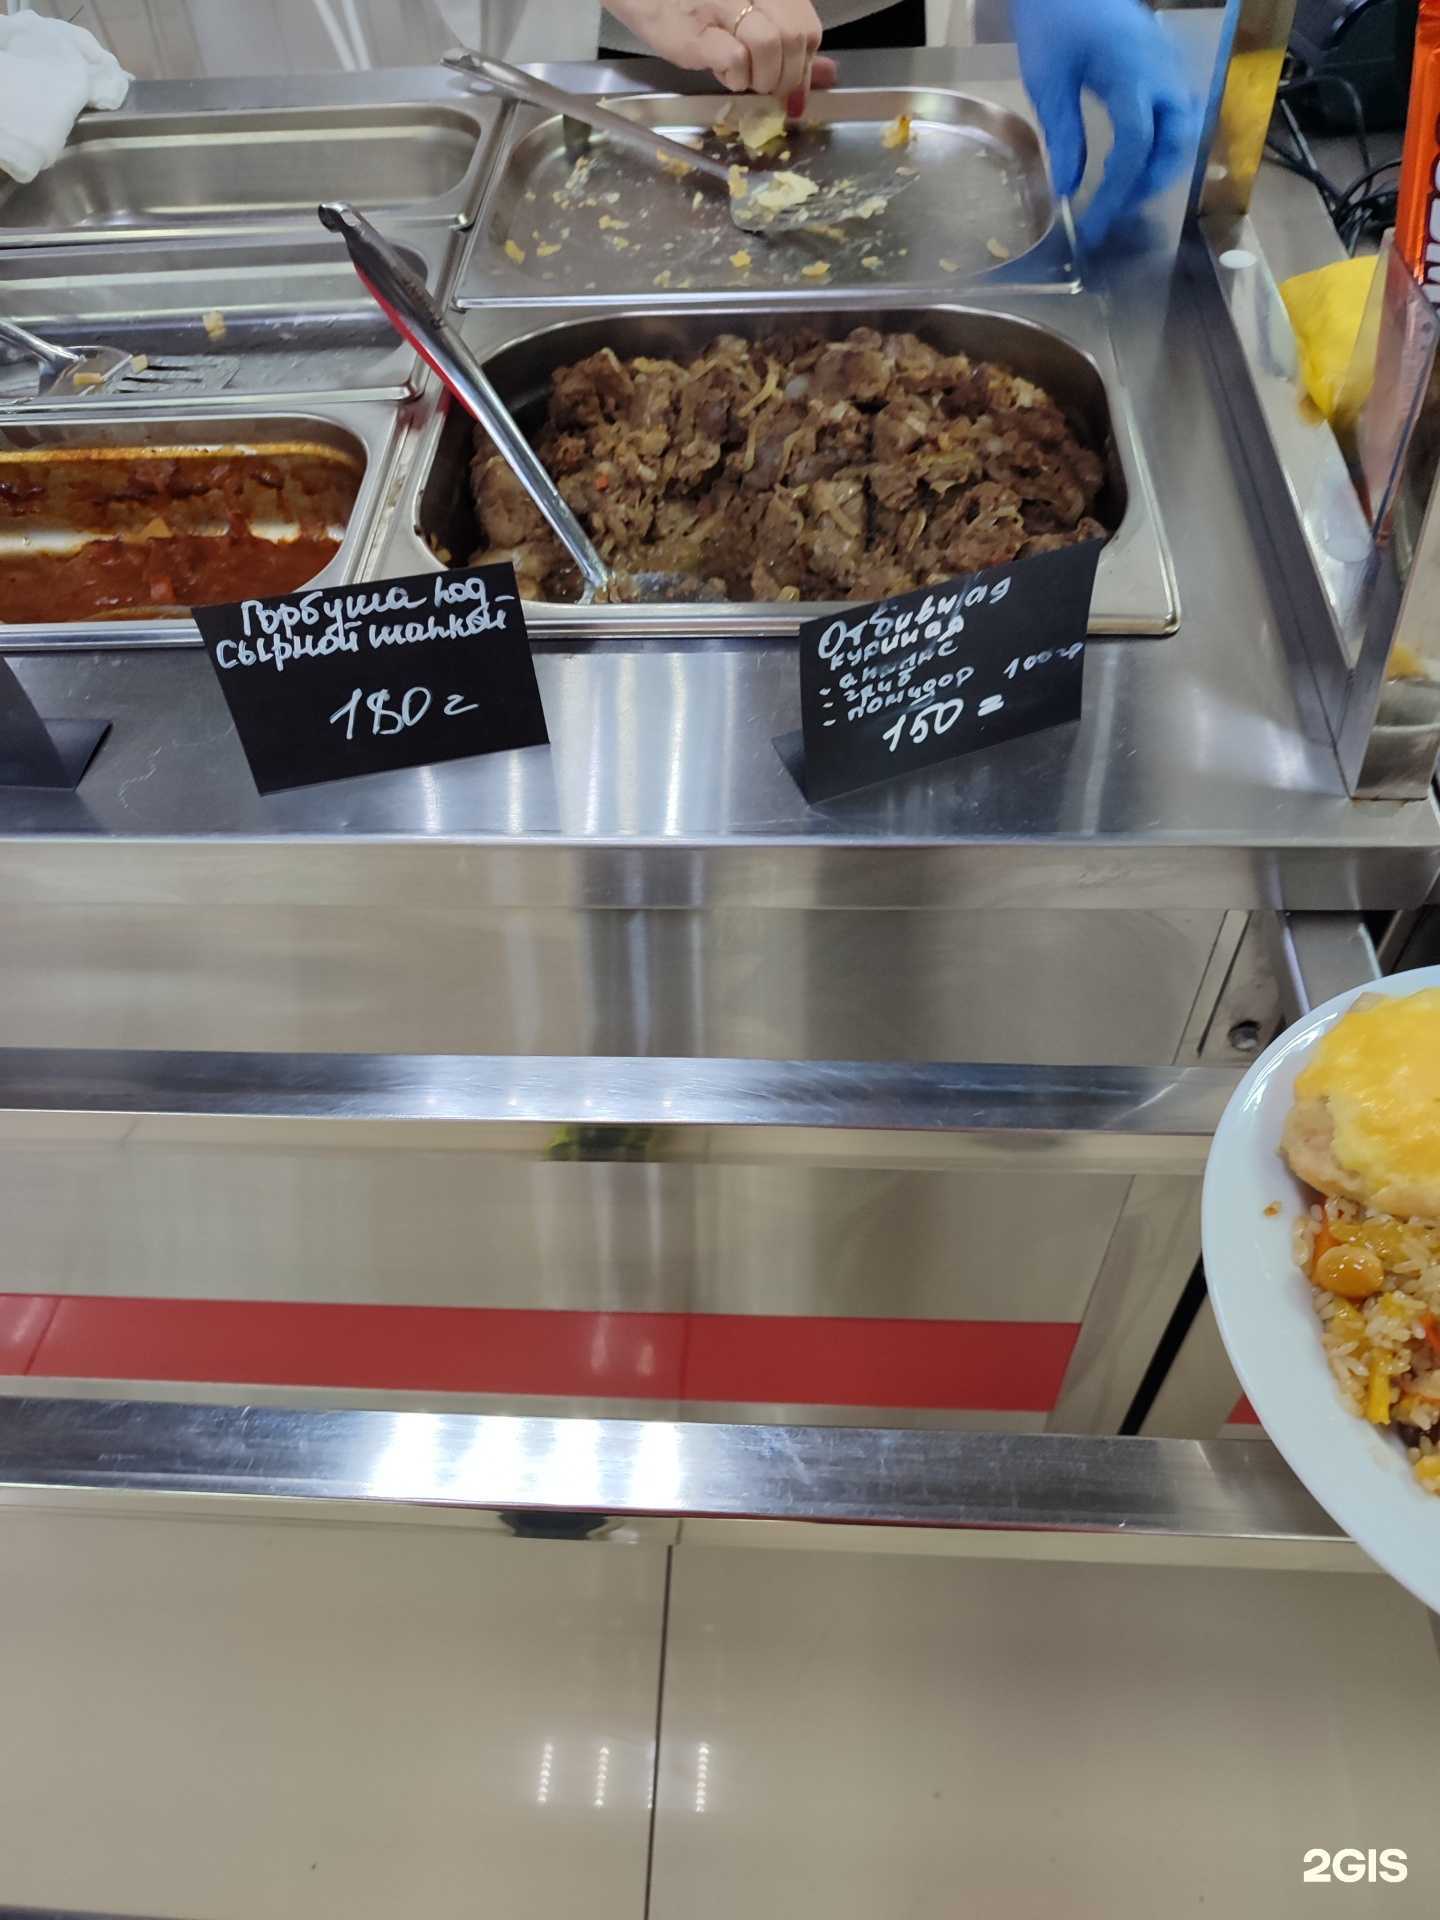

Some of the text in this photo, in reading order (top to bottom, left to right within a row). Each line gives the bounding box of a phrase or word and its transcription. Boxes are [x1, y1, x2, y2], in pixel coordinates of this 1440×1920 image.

[216, 595, 515, 671] сырной шапкой
[241, 576, 488, 638] Горбуша под
[330, 687, 432, 739] 180
[882, 698, 964, 752] 150
